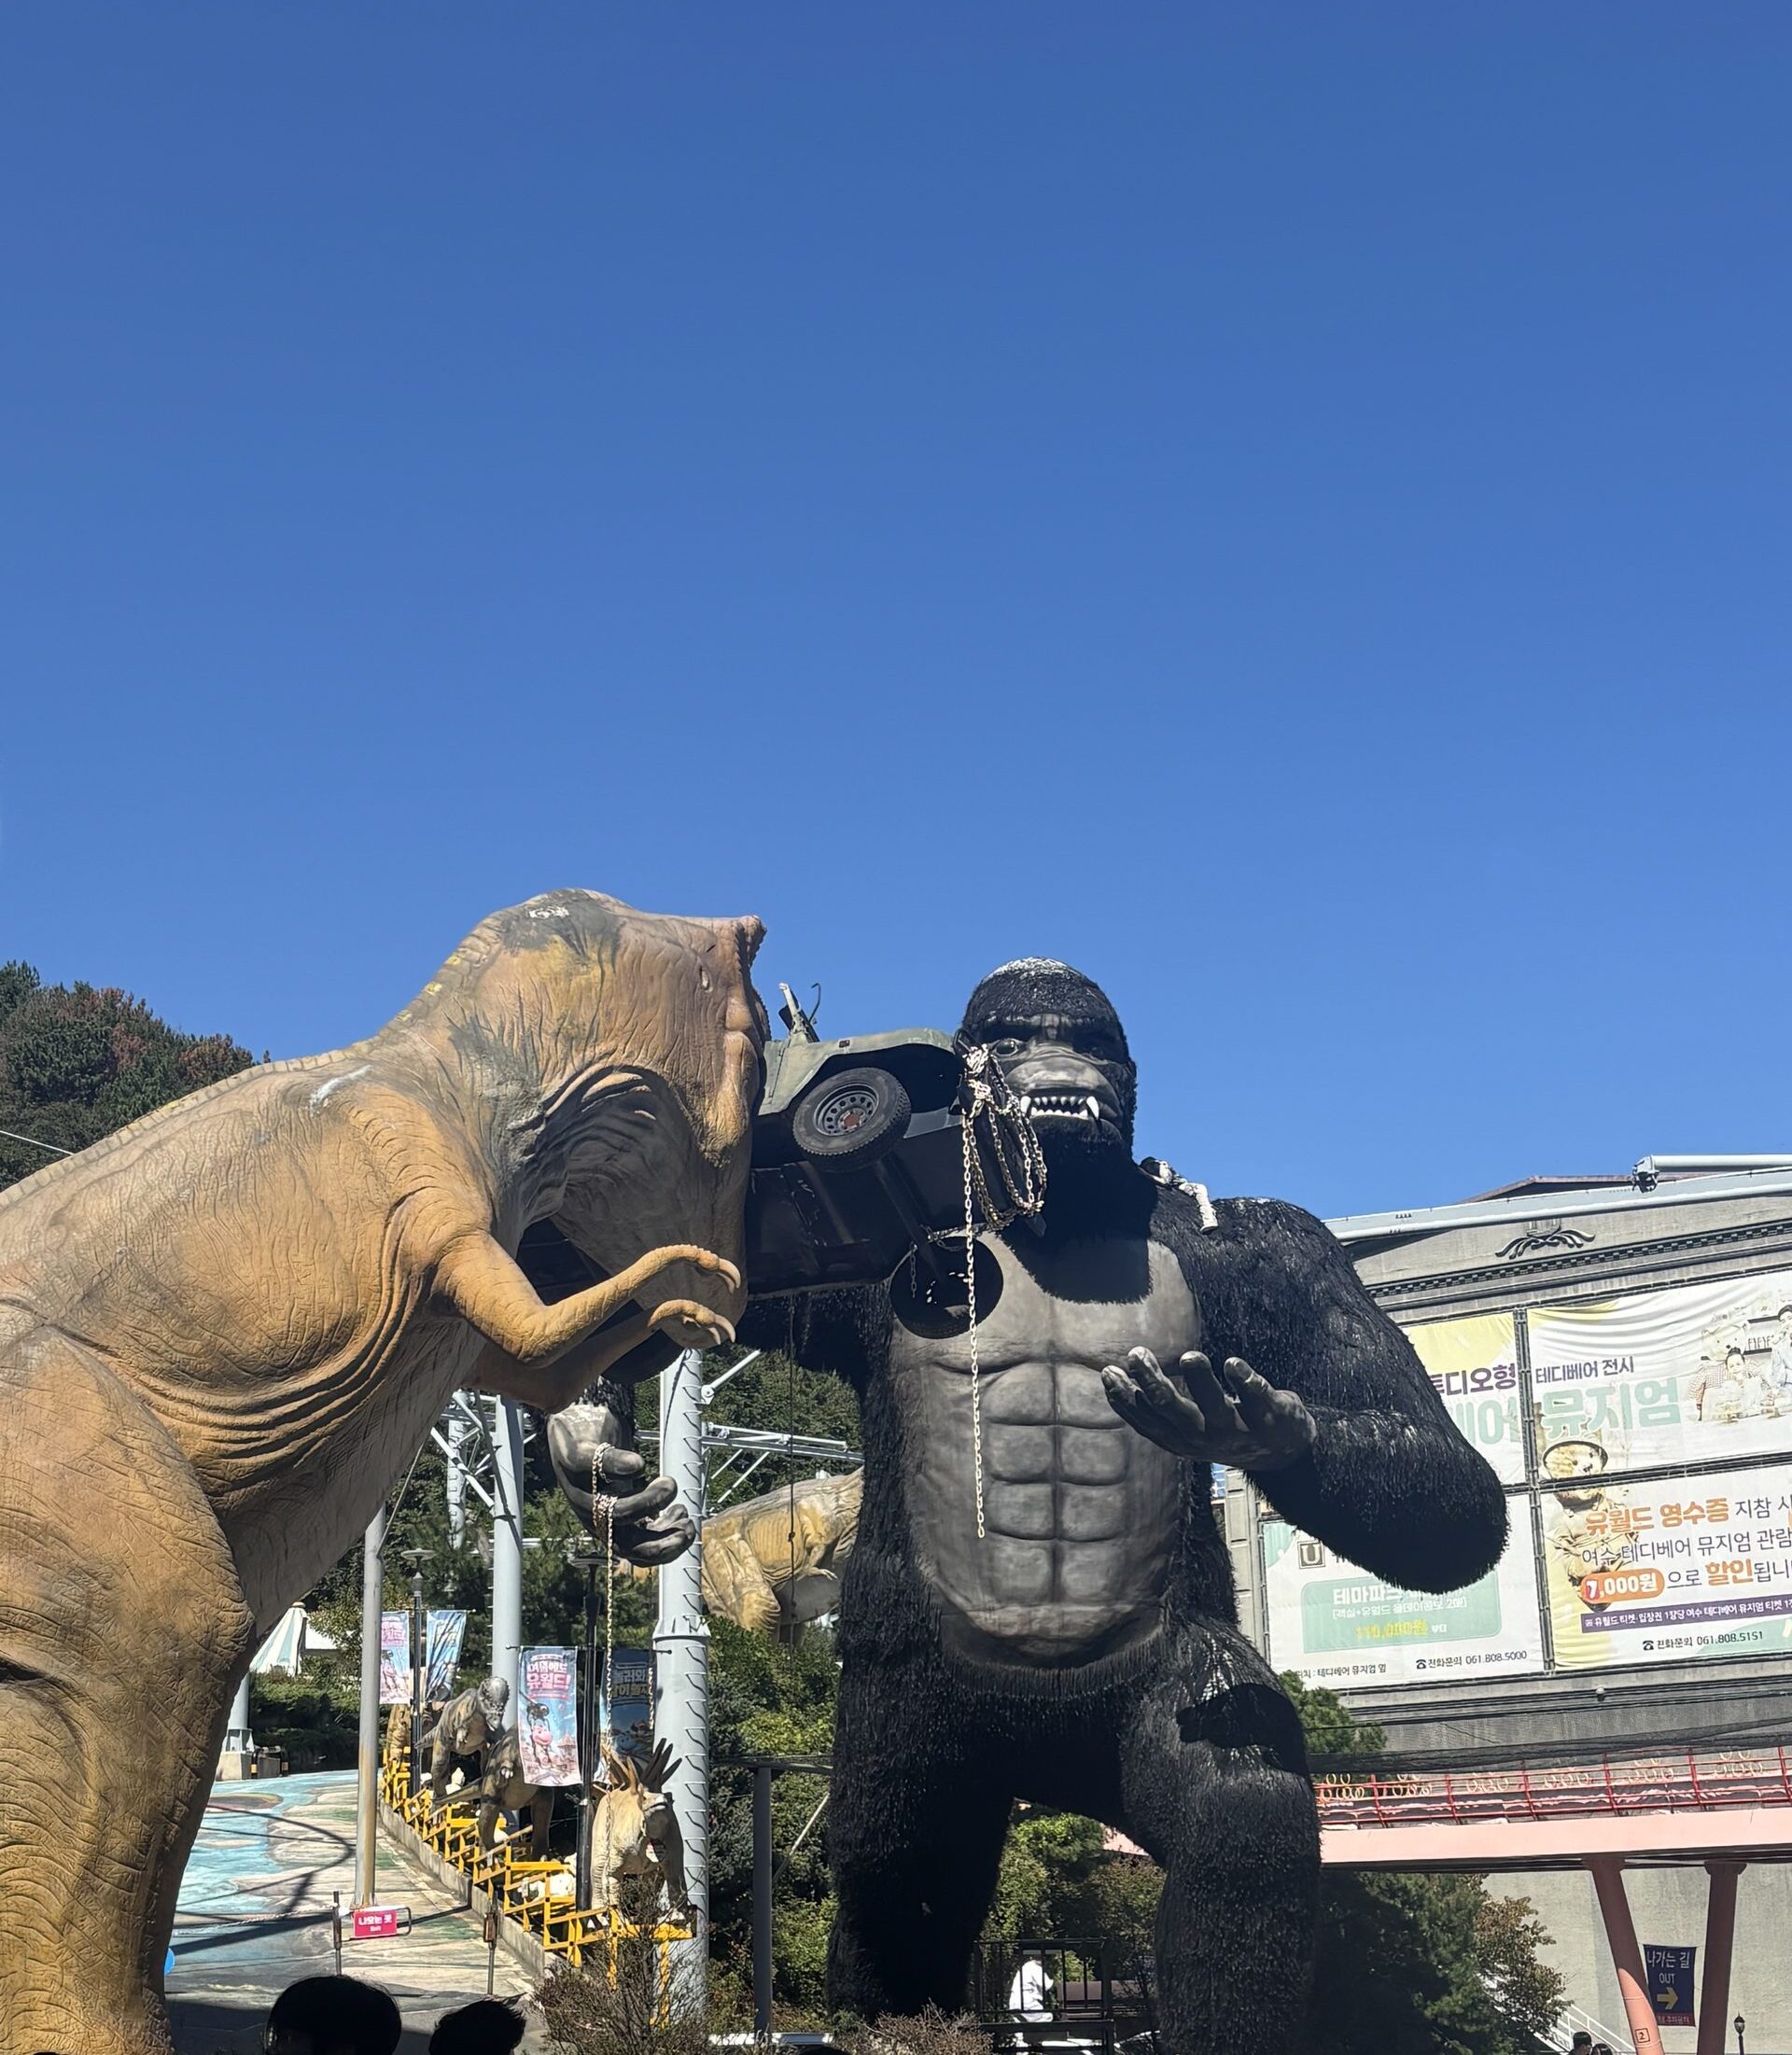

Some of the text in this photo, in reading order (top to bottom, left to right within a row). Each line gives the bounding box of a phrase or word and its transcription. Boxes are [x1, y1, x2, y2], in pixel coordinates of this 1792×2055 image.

[1535, 1361, 1599, 1384] 테디베어
[1602, 1356, 1635, 1377] 전시
[1542, 1377, 1681, 1438] 뮤지엄
[1586, 1506, 1655, 1536] 유월드
[1659, 1498, 1729, 1529] 영수증
[1735, 1497, 1771, 1519] 지참
[1582, 1528, 1792, 1566] 여수 테디베어 뮤지엄 관람
[1587, 1559, 1792, 1600] 7,000원 으로 할인됩니
[1657, 1630, 1763, 1650] 전화문의 061.808.5151
[1428, 1650, 1527, 1669] 전화문의 061.808.5000
[1646, 1950, 1690, 1969] 나가는 길
[1659, 1972, 1675, 1984] OUT
